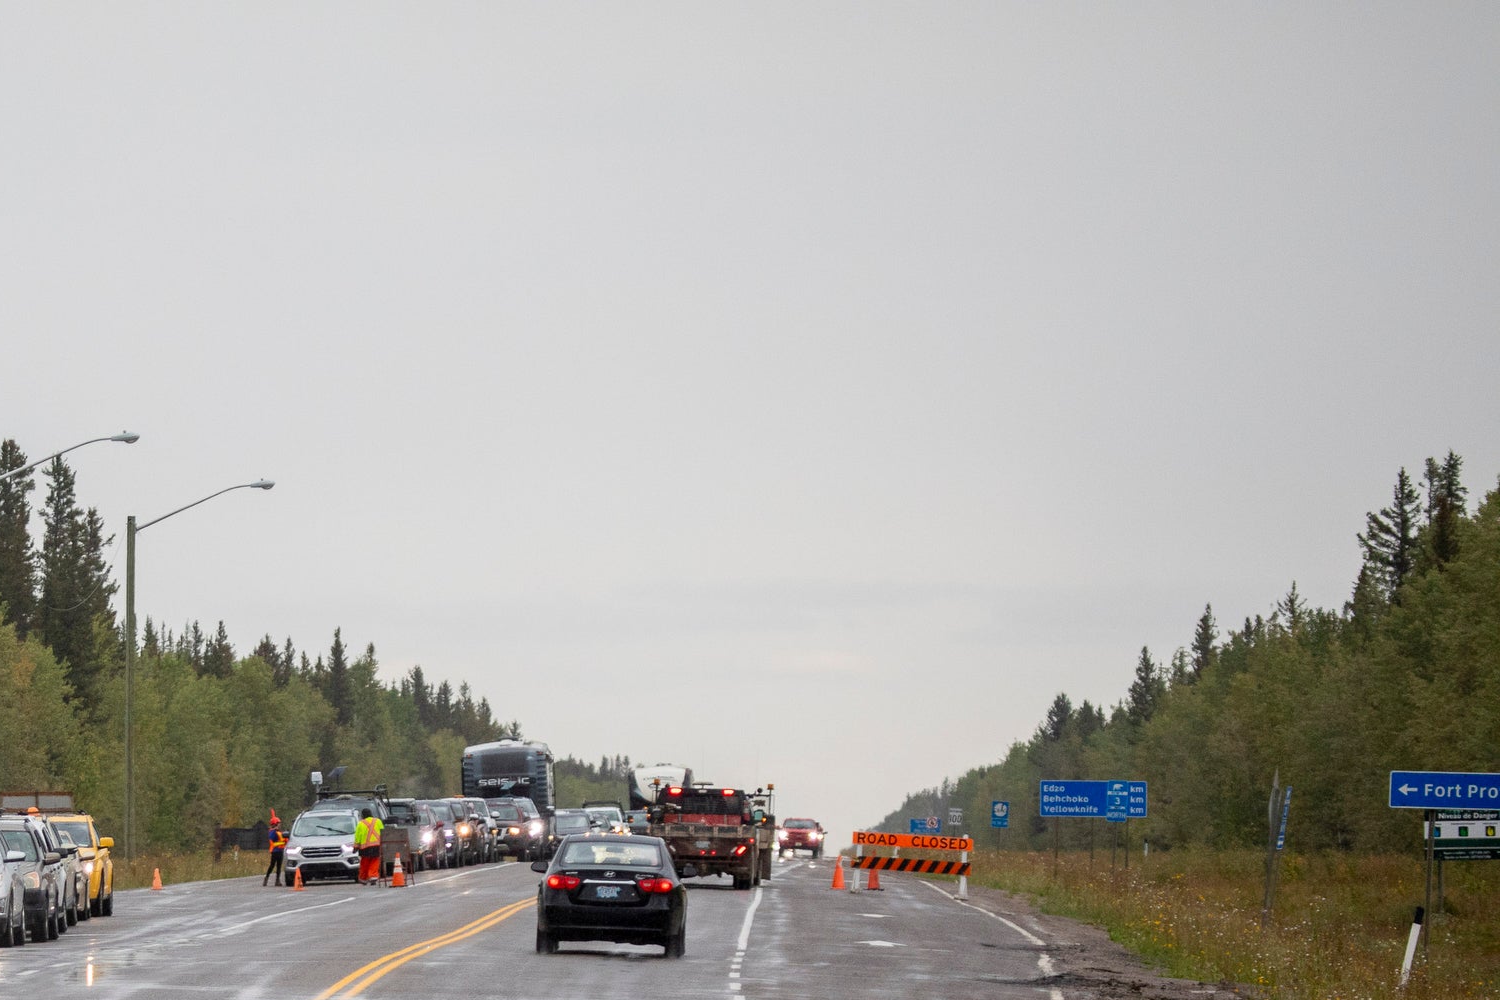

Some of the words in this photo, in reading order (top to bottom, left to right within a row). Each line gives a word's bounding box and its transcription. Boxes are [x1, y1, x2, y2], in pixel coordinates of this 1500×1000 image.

[1043, 784, 1065, 792] Edzo
[1424, 783, 1461, 798] Fort
[1467, 784, 1500, 799] Pro
[1043, 795, 1089, 803] Behchoko
[1115, 797, 1120, 805] 3
[1044, 805, 1098, 813] Yellowknife
[1473, 812, 1498, 820] Danger
[857, 832, 898, 846] ROAD
[911, 836, 968, 850] CLOSED
